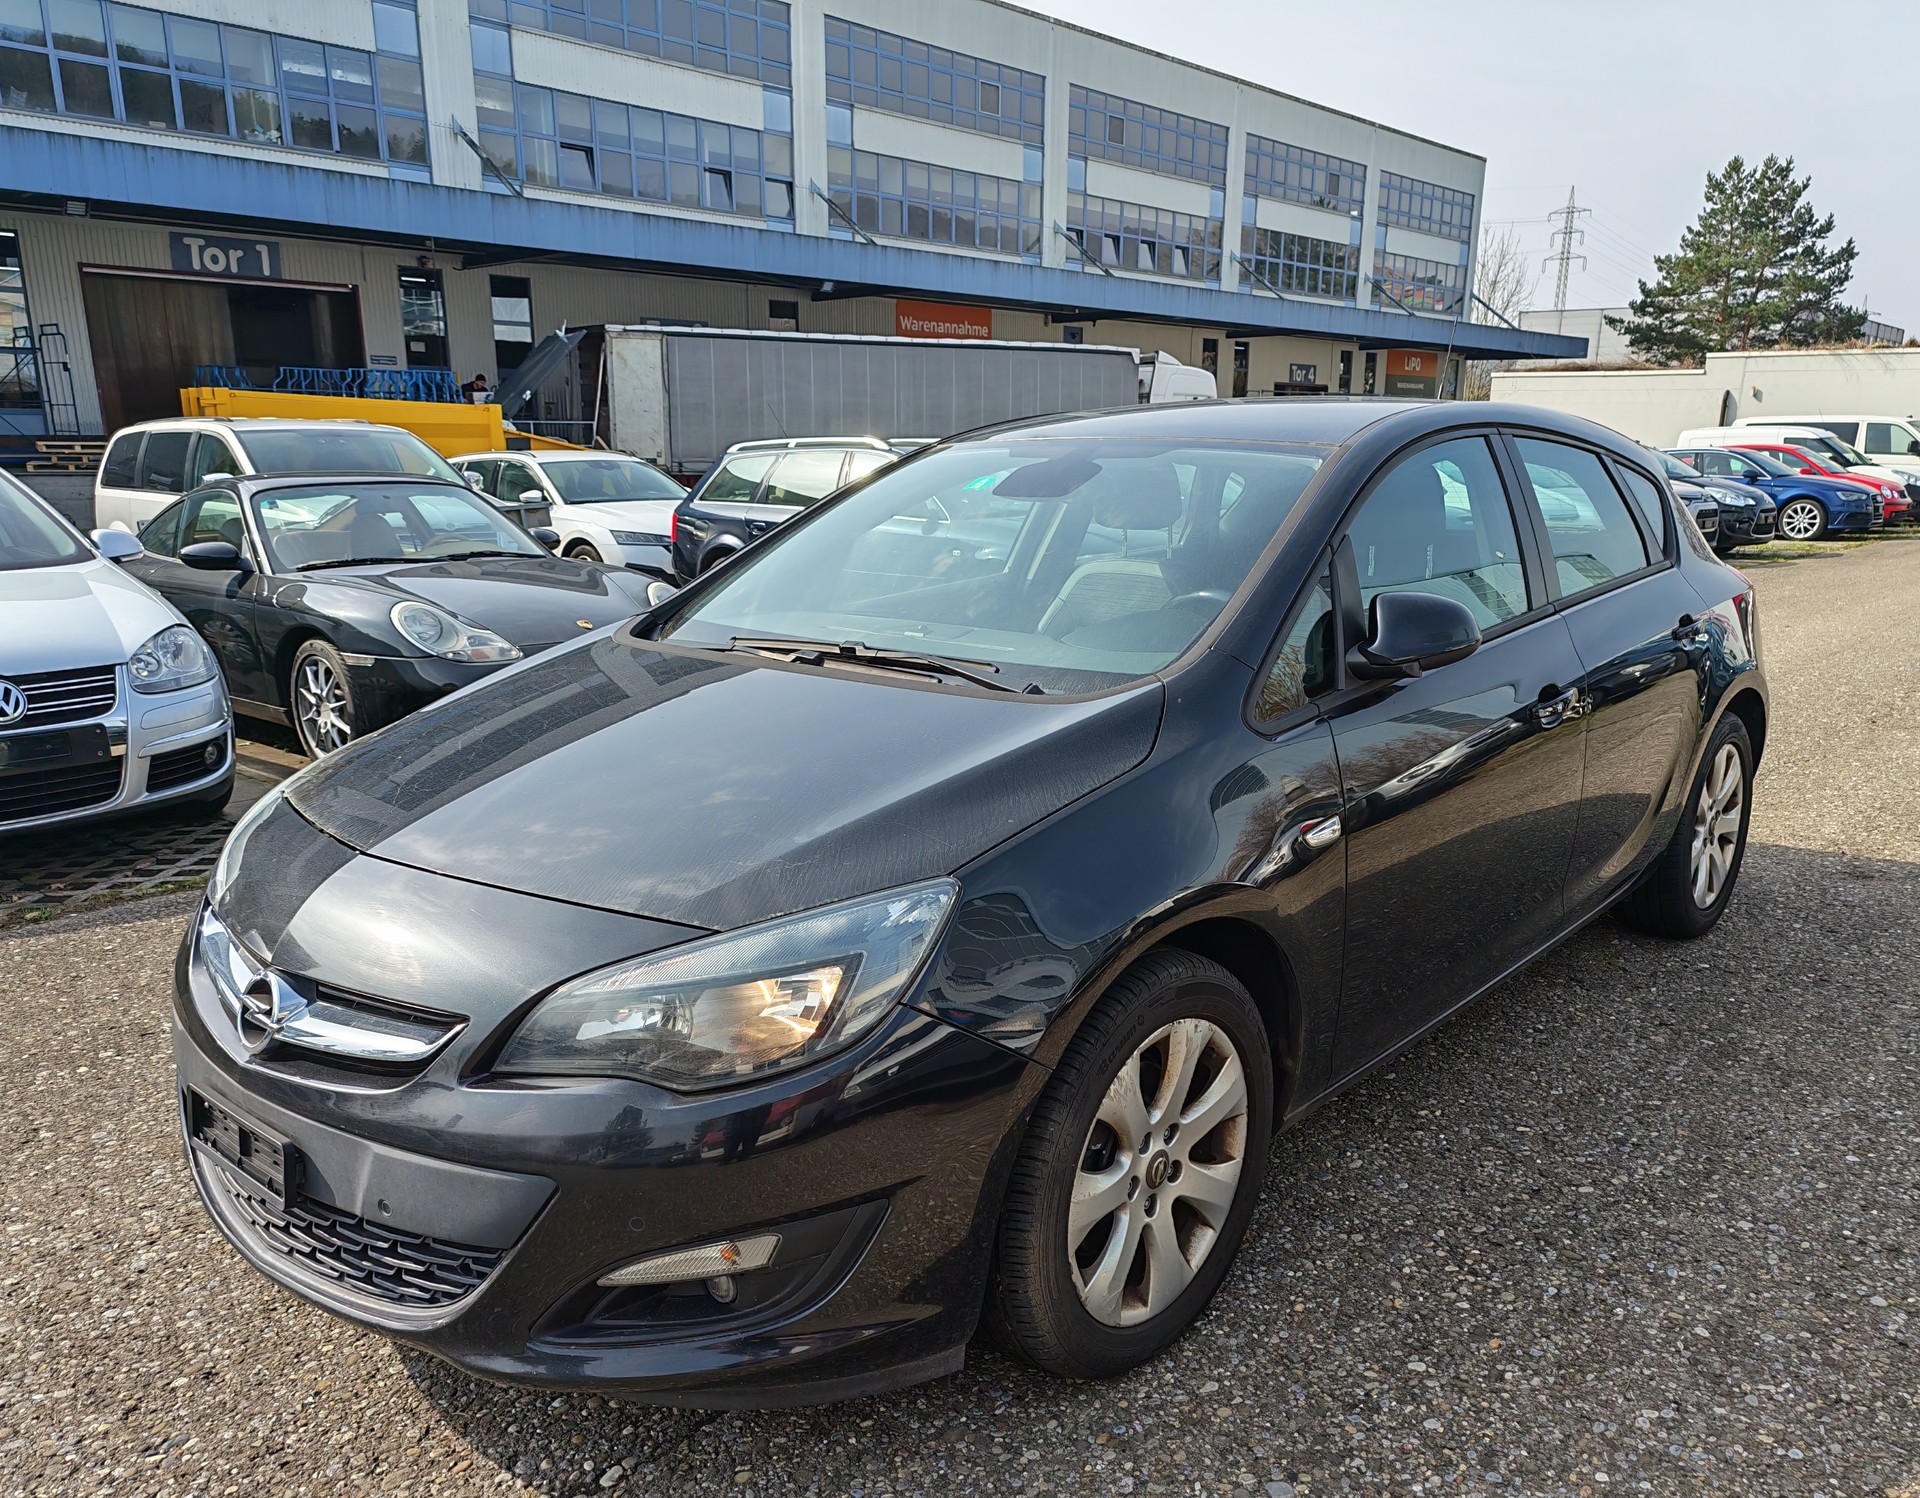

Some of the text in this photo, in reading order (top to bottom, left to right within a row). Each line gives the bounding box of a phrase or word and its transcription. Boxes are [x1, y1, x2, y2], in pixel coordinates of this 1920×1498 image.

[183, 237, 270, 276] Tor 1
[900, 315, 988, 337] Warenannahme
[1291, 365, 1315, 383] Tor 4
